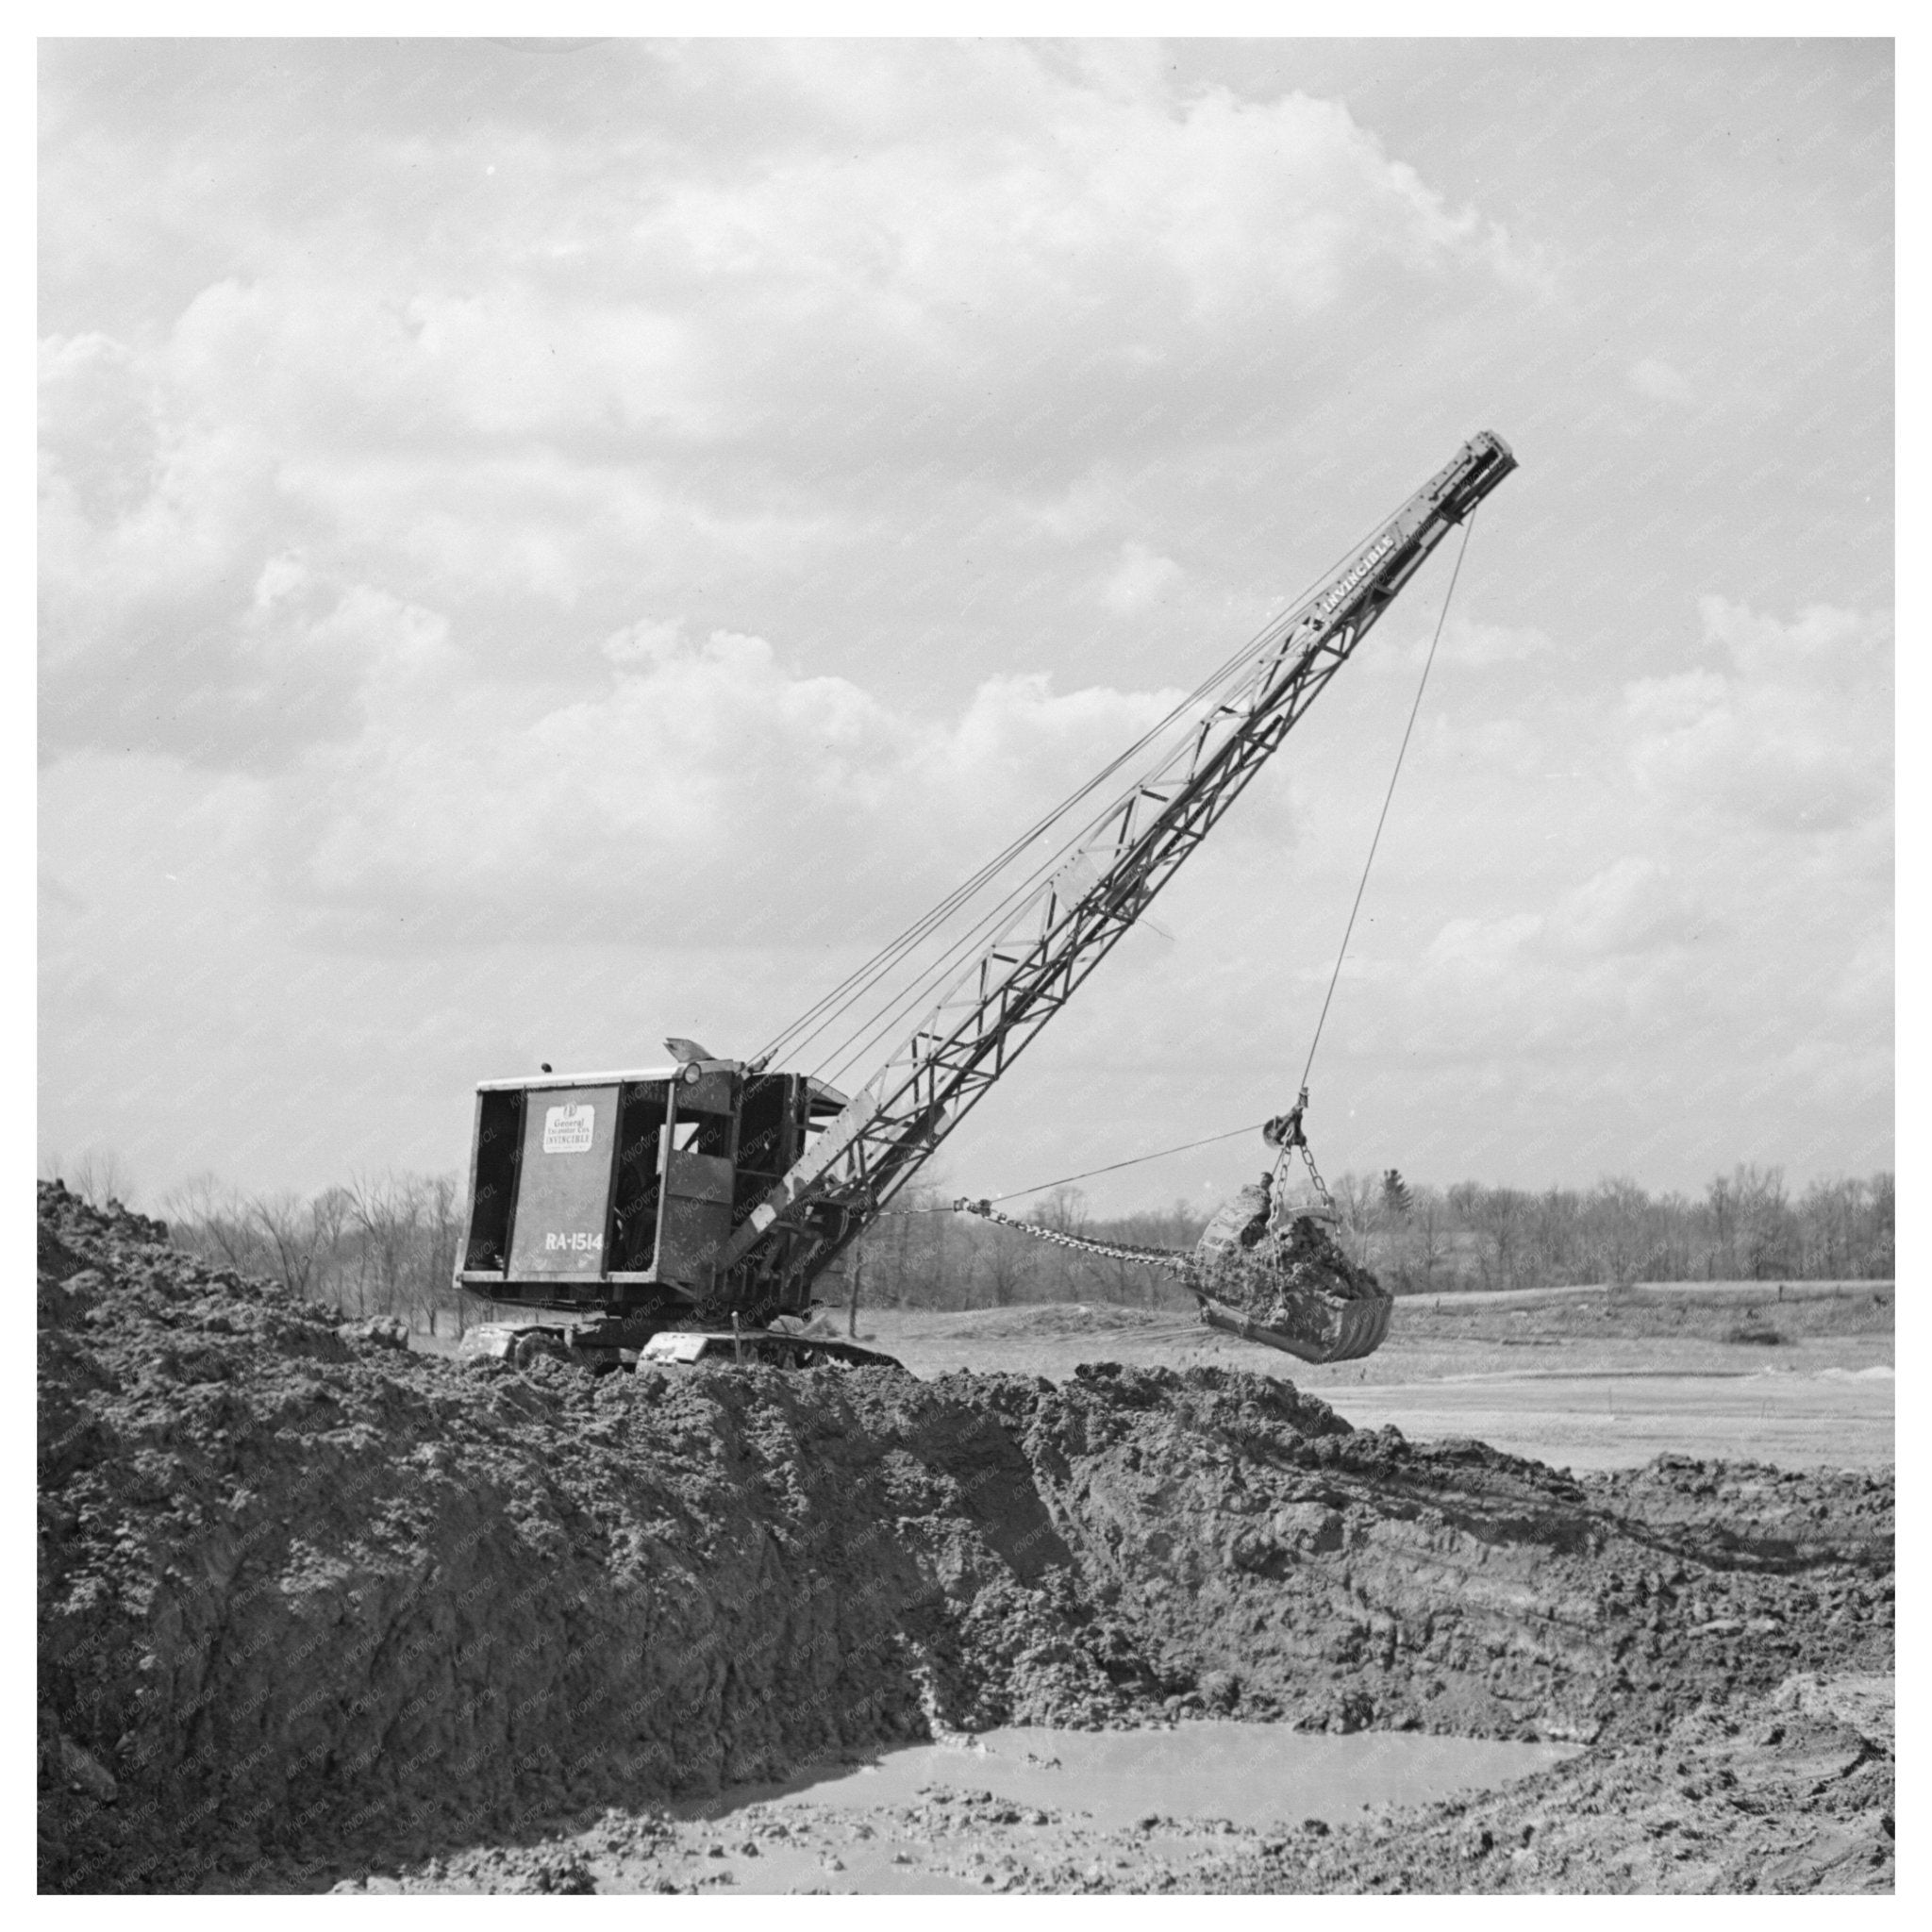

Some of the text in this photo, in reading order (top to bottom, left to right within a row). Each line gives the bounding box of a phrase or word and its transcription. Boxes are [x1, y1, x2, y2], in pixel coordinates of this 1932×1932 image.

[1322, 536, 1394, 612] INVINCIBLE
[554, 1118, 584, 1127] General
[545, 1134, 590, 1144] INVINCIBLE
[545, 1232, 603, 1251] RA-1514
